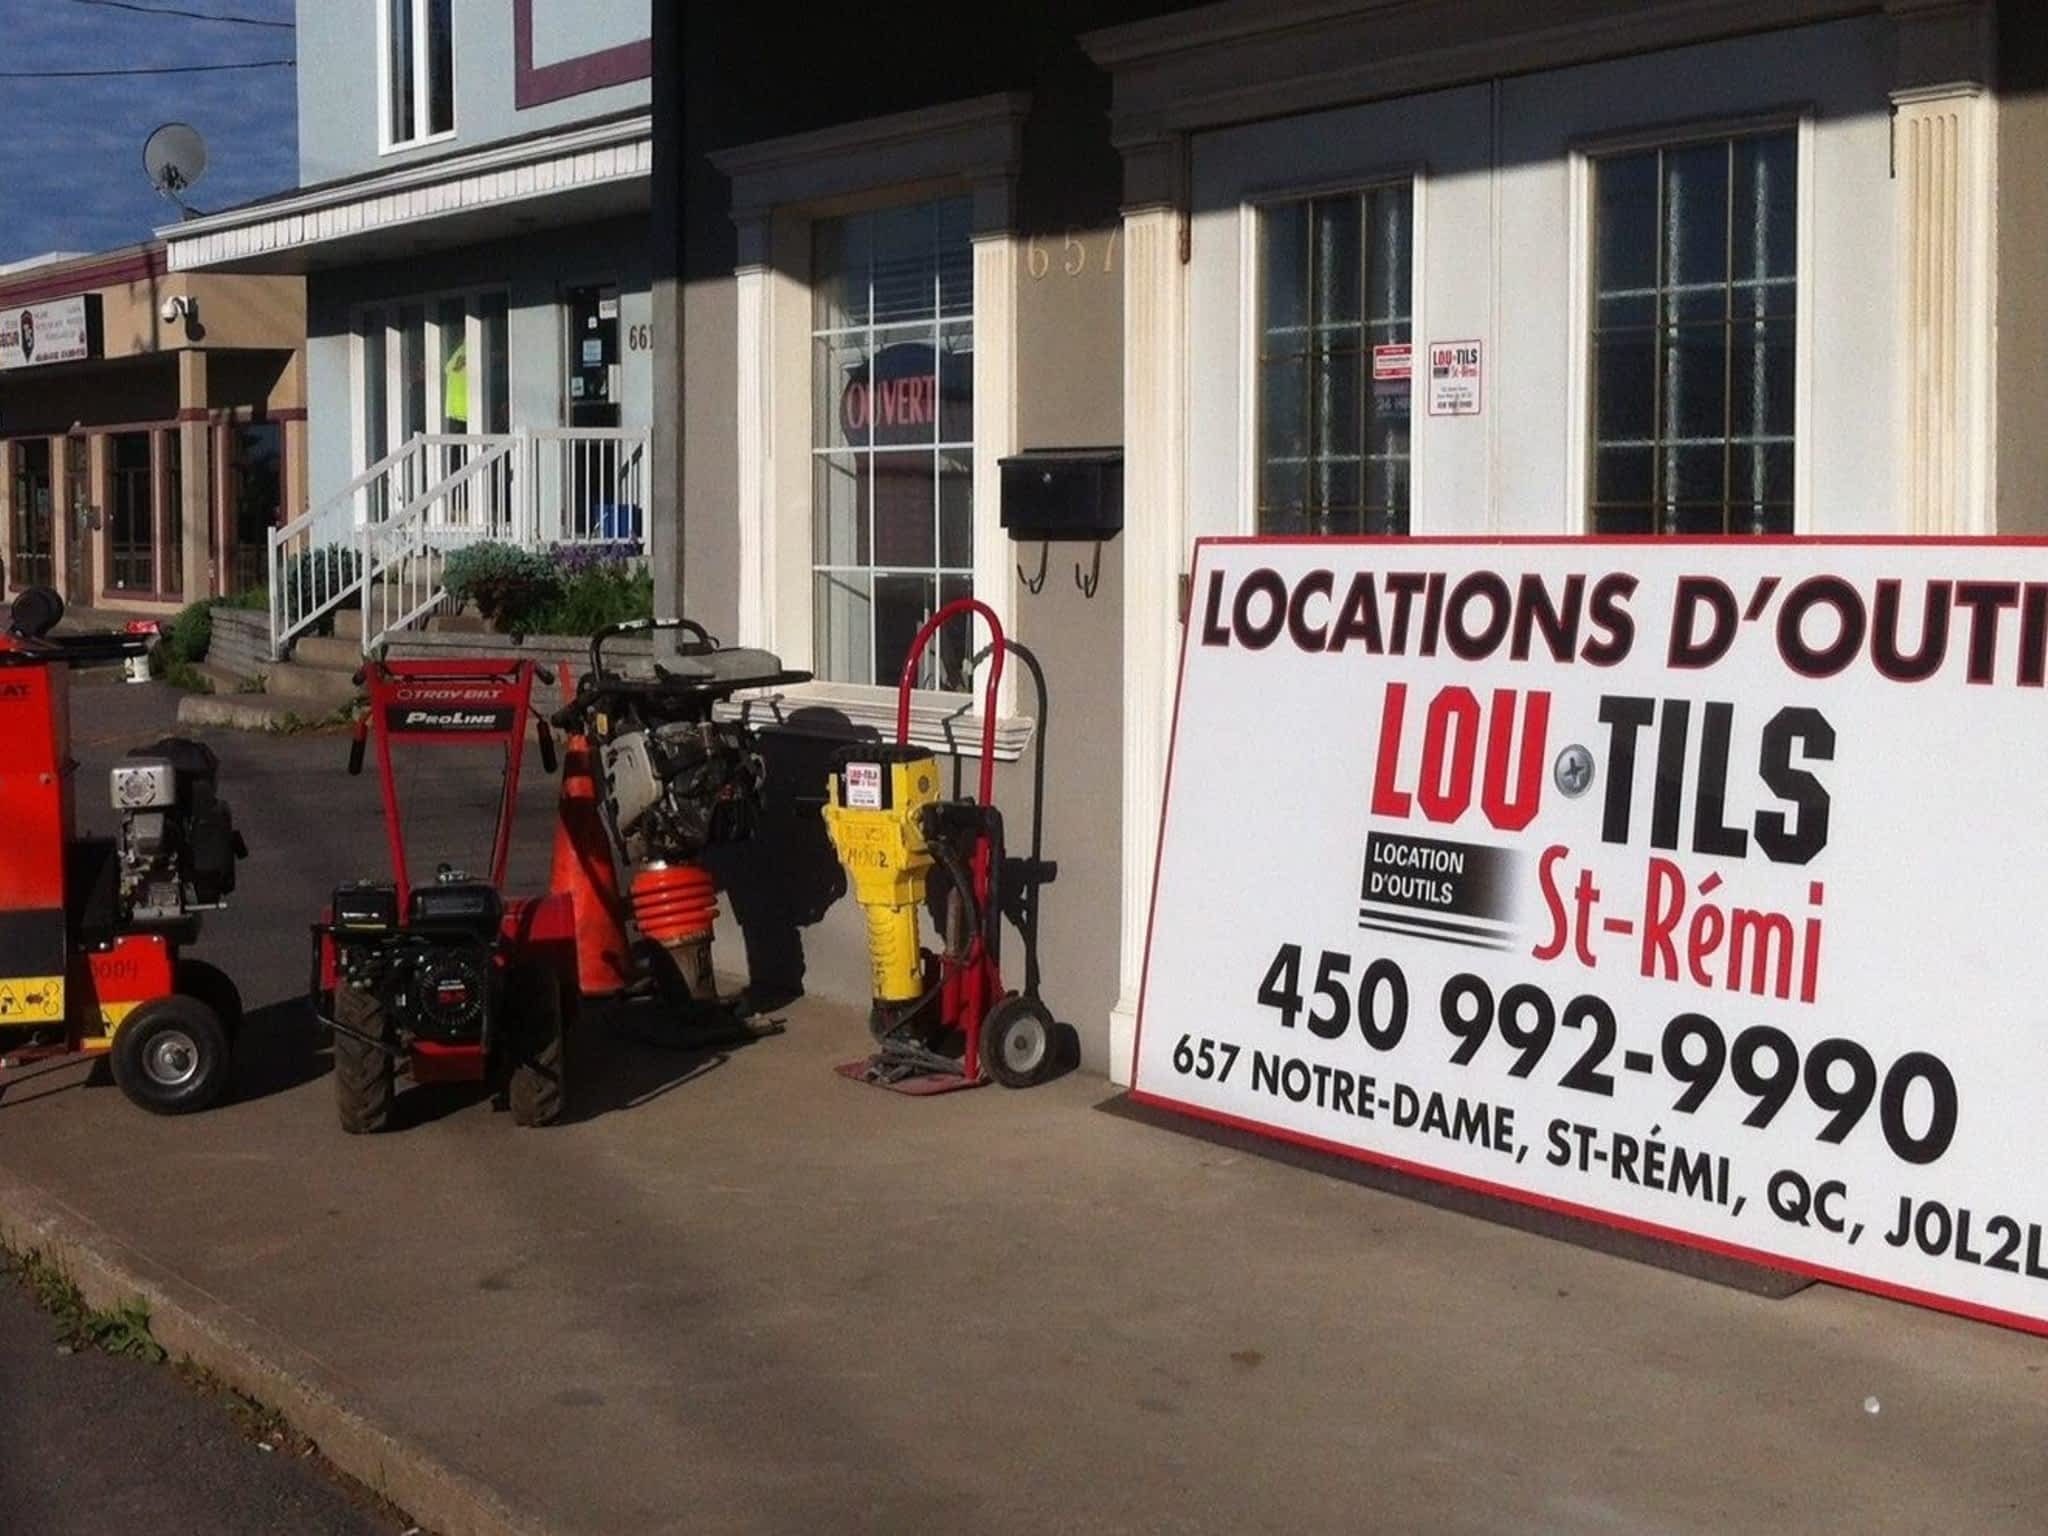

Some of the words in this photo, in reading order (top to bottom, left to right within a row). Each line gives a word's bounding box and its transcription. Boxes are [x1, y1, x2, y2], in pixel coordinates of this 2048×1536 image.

[1027, 226, 1119, 280] 657
[846, 375, 936, 429] OUVERT
[1202, 569, 1639, 667] LOCATIONS
[1667, 575, 2048, 688] D'OUTI
[414, 688, 503, 699] TROY-BILT
[1371, 683, 1551, 832] LOU
[1598, 695, 1836, 866] TILS
[1370, 871, 1453, 905] D'OUTILS
[1373, 842, 1465, 875] LOCATION
[1532, 845, 1824, 1003] St-Rémi
[1257, 943, 1409, 1052] 450
[1439, 972, 1958, 1165] 992-9990
[1173, 1033, 1241, 1083] 657
[1251, 1050, 1529, 1165] NOTRE-DAME,
[1546, 1118, 1748, 1217] ST-RÉMI,
[1767, 1169, 1865, 1245] QC,
